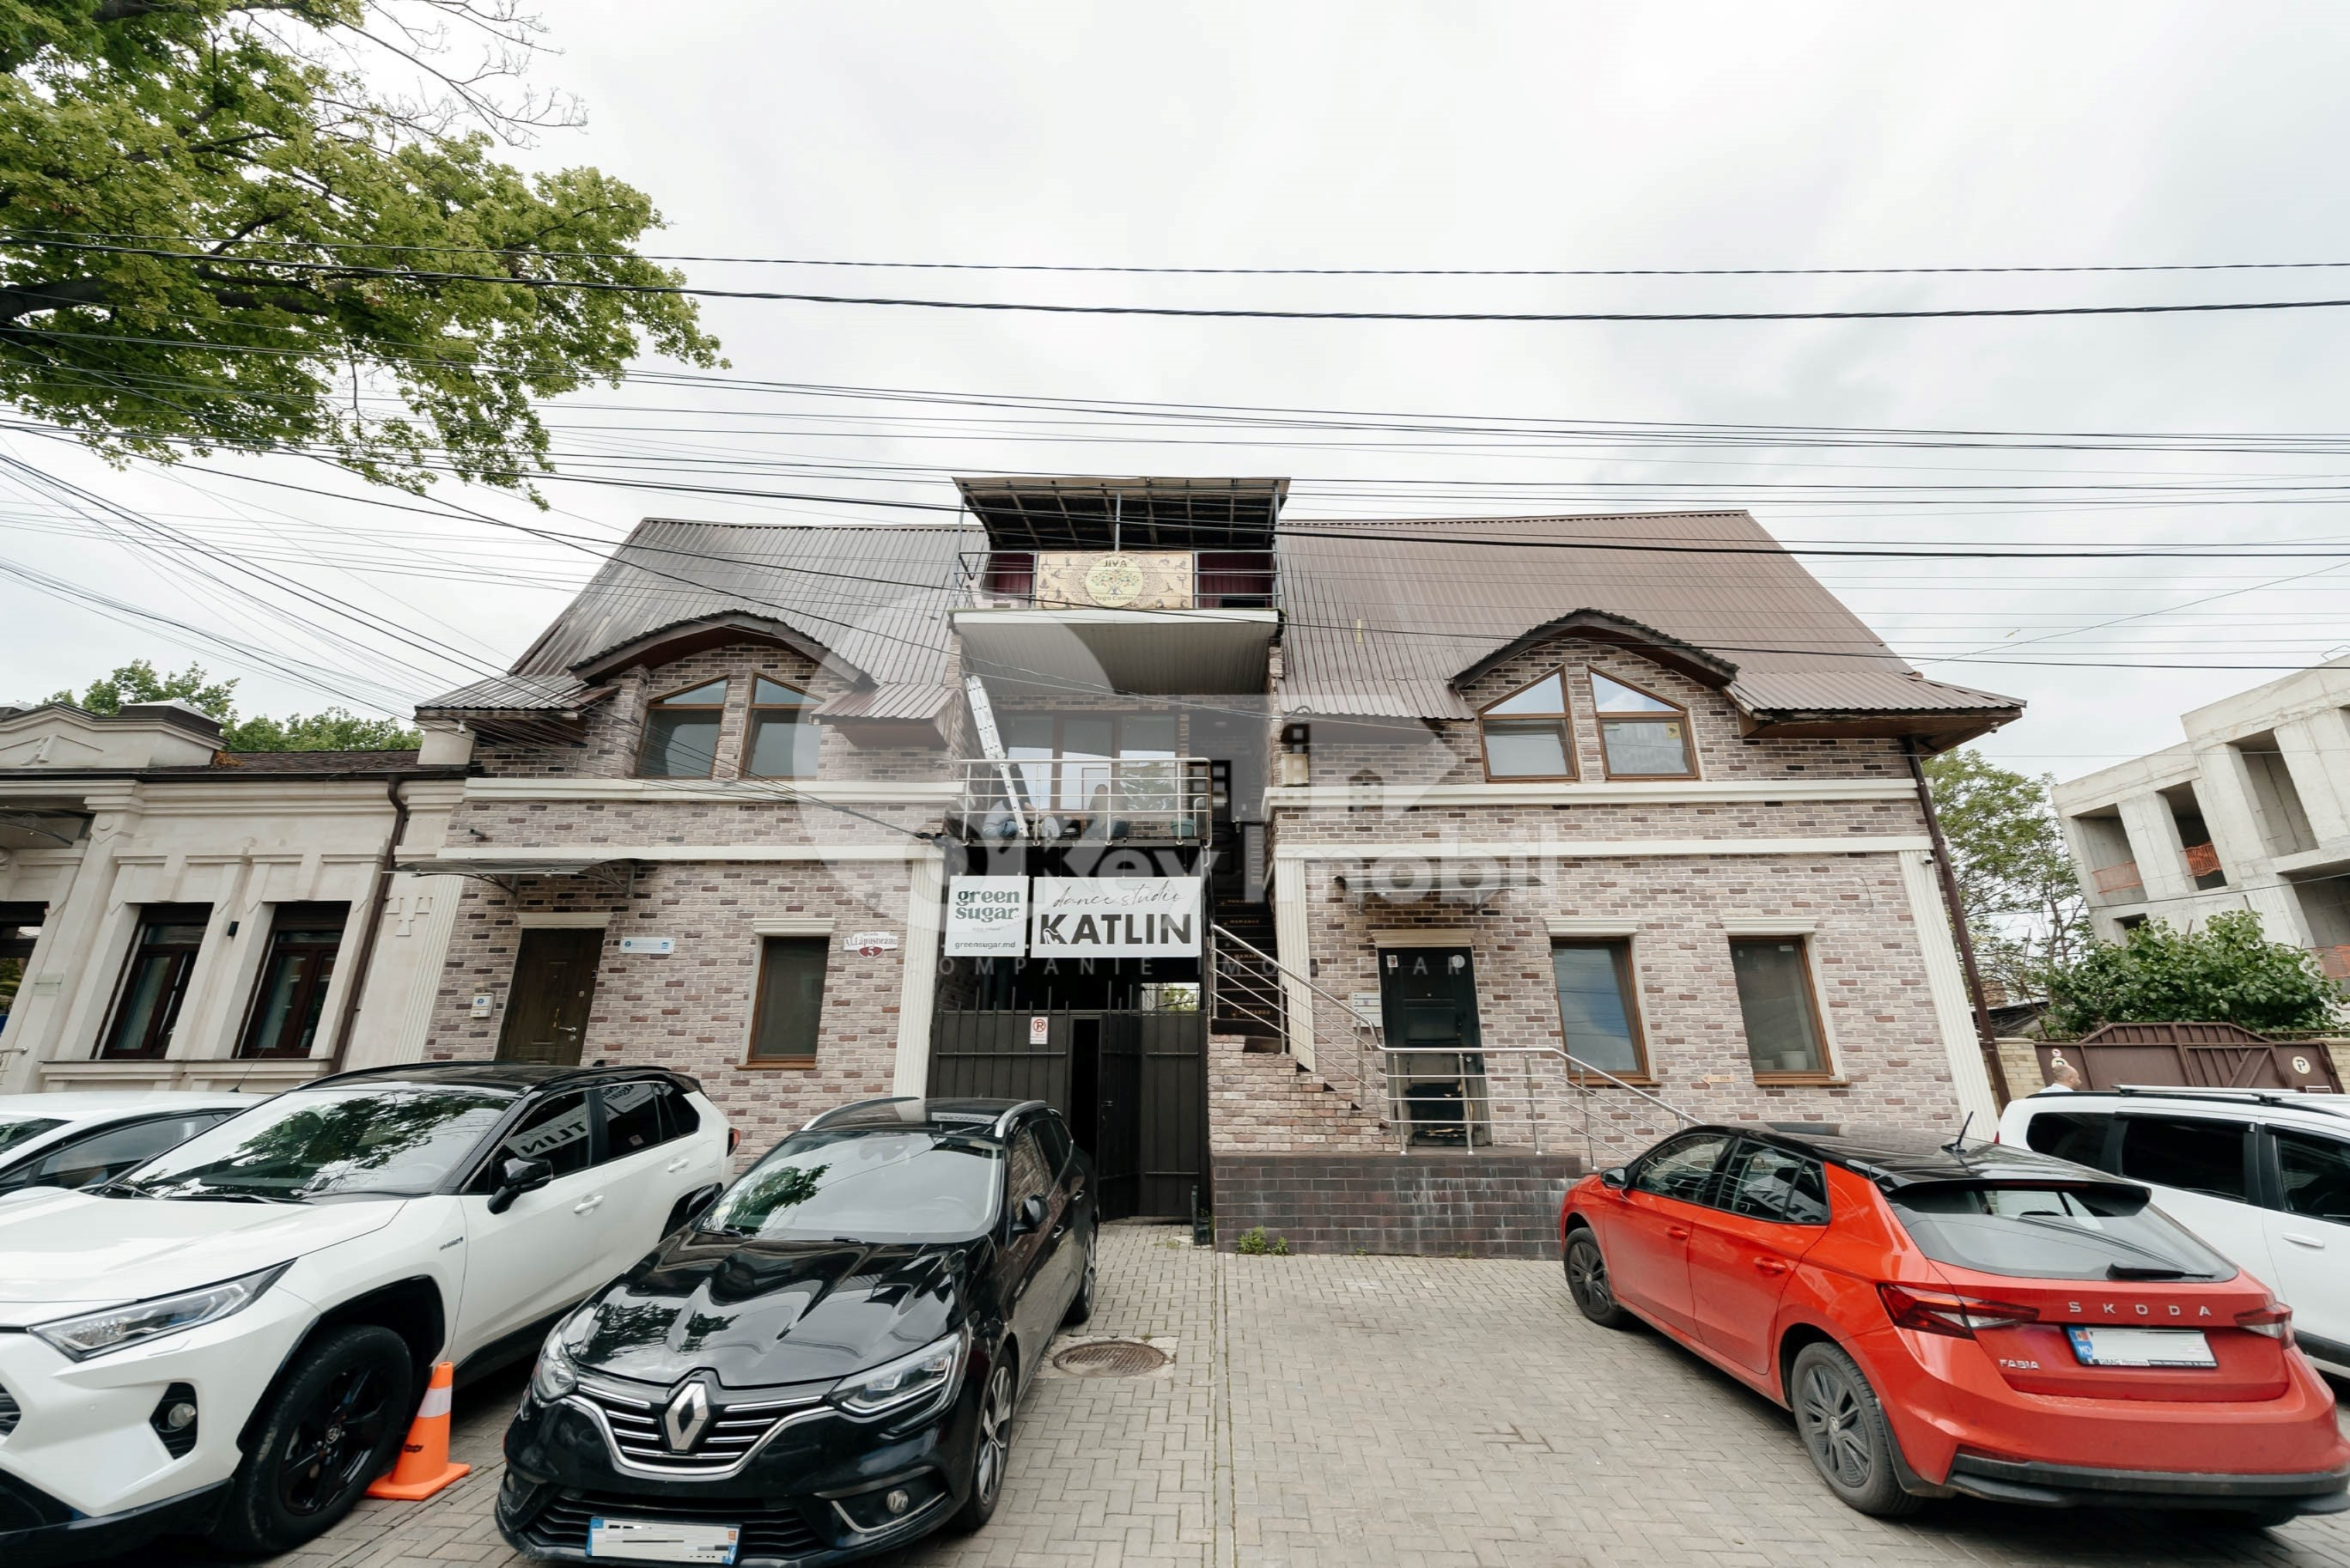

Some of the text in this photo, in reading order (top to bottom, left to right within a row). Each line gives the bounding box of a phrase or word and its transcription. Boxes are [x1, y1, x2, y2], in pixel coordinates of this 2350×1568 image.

[955, 890, 1020, 907] green
[1052, 879, 1184, 909] dance studio
[1039, 913, 1192, 945] KATLIN
[868, 946, 874, 957] 5
[954, 941, 1016, 950] greensugar.md
[2068, 1301, 2212, 1316] SKODA
[2079, 1346, 2091, 1355] MD
[1999, 1358, 2041, 1370] FABIA
